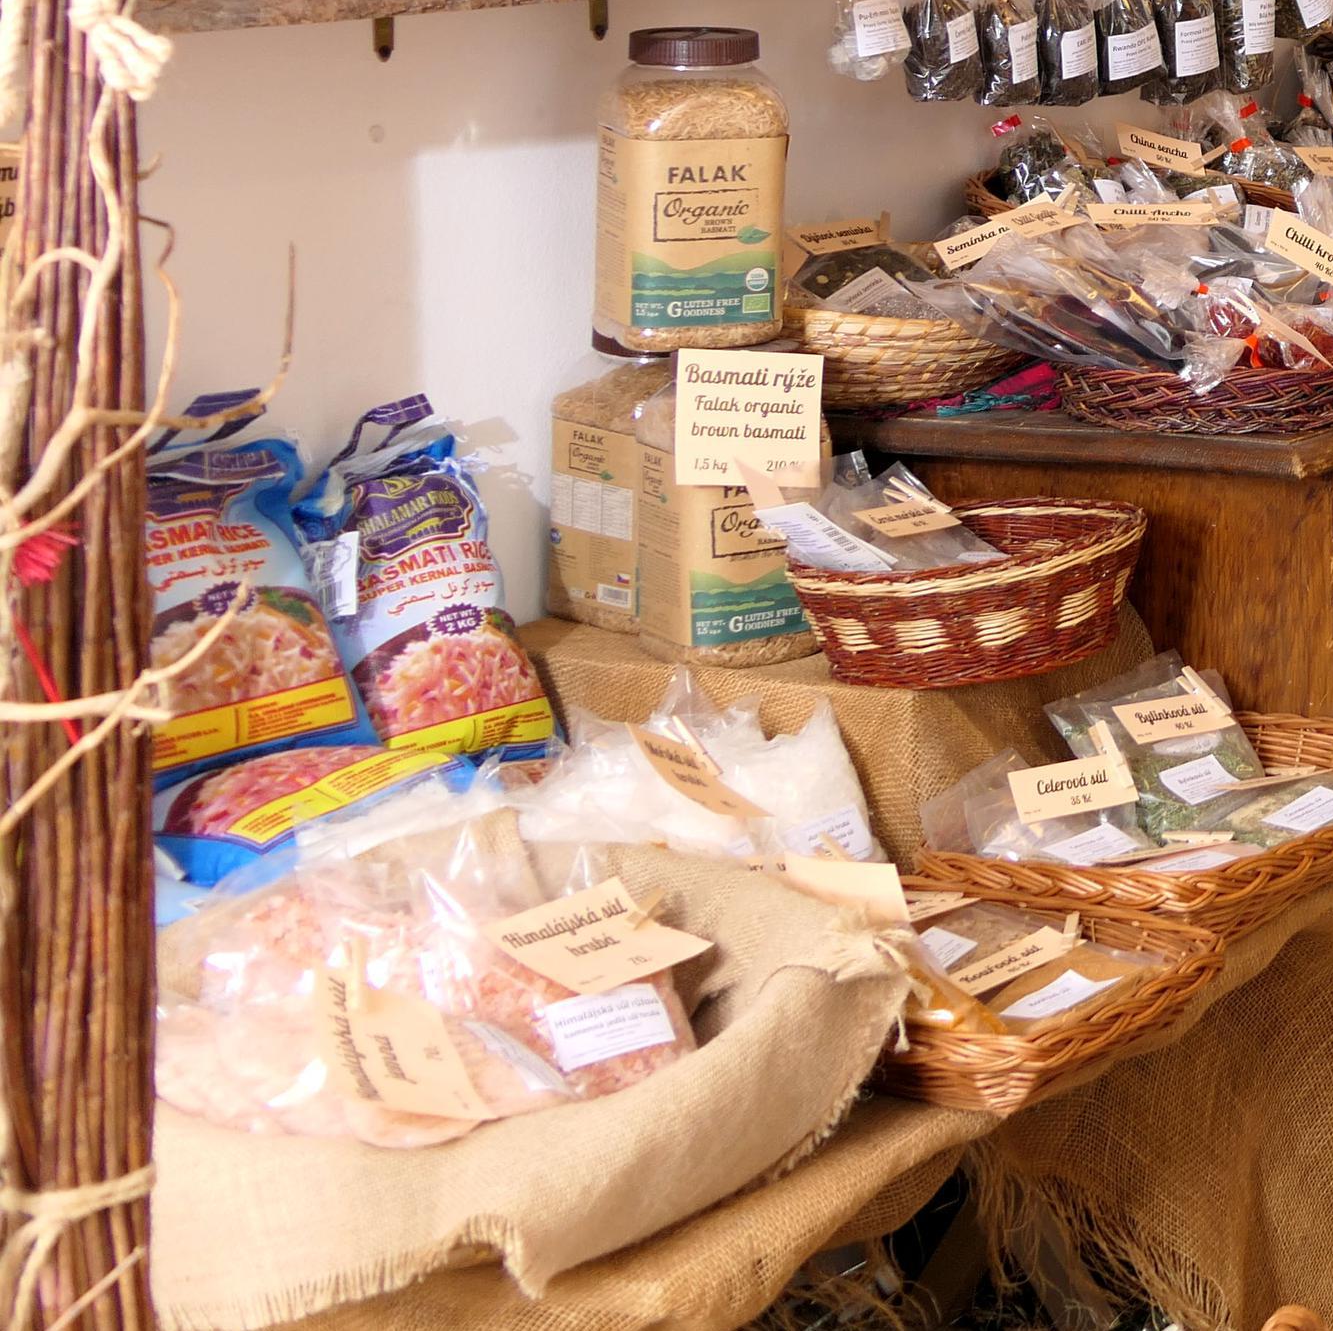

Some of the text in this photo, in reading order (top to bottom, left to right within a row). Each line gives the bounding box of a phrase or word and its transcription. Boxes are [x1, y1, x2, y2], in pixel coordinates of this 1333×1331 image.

[1130, 133, 1190, 160] China sencha
[667, 163, 748, 185] FALAK
[663, 197, 750, 226] Organic
[704, 218, 733, 226] BROWN
[1113, 207, 1192, 217] Chilli Ancho
[700, 226, 737, 234] BASMATI
[945, 228, 1000, 256] Semínka
[1284, 226, 1316, 253] Chilli
[715, 298, 741, 307] FREE
[685, 363, 817, 394] Basmati rýže
[693, 394, 805, 419] Falak organic
[572, 429, 605, 446] FALAK
[691, 422, 807, 441] brown basmati
[571, 446, 607, 466] Organic
[712, 458, 728, 474] kg
[358, 539, 493, 592] BASMATI RICE
[359, 566, 463, 604] SUPER KERNAL
[438, 614, 459, 624] NET
[775, 606, 801, 617] FREE
[456, 619, 477, 631] KG
[1135, 701, 1210, 726] Bylinková sůl
[1036, 768, 1110, 797] Celerová sůl
[501, 896, 630, 951] Himalájská sůl
[565, 934, 621, 959] hrubá
[959, 942, 1043, 985] Kouřová sůl
